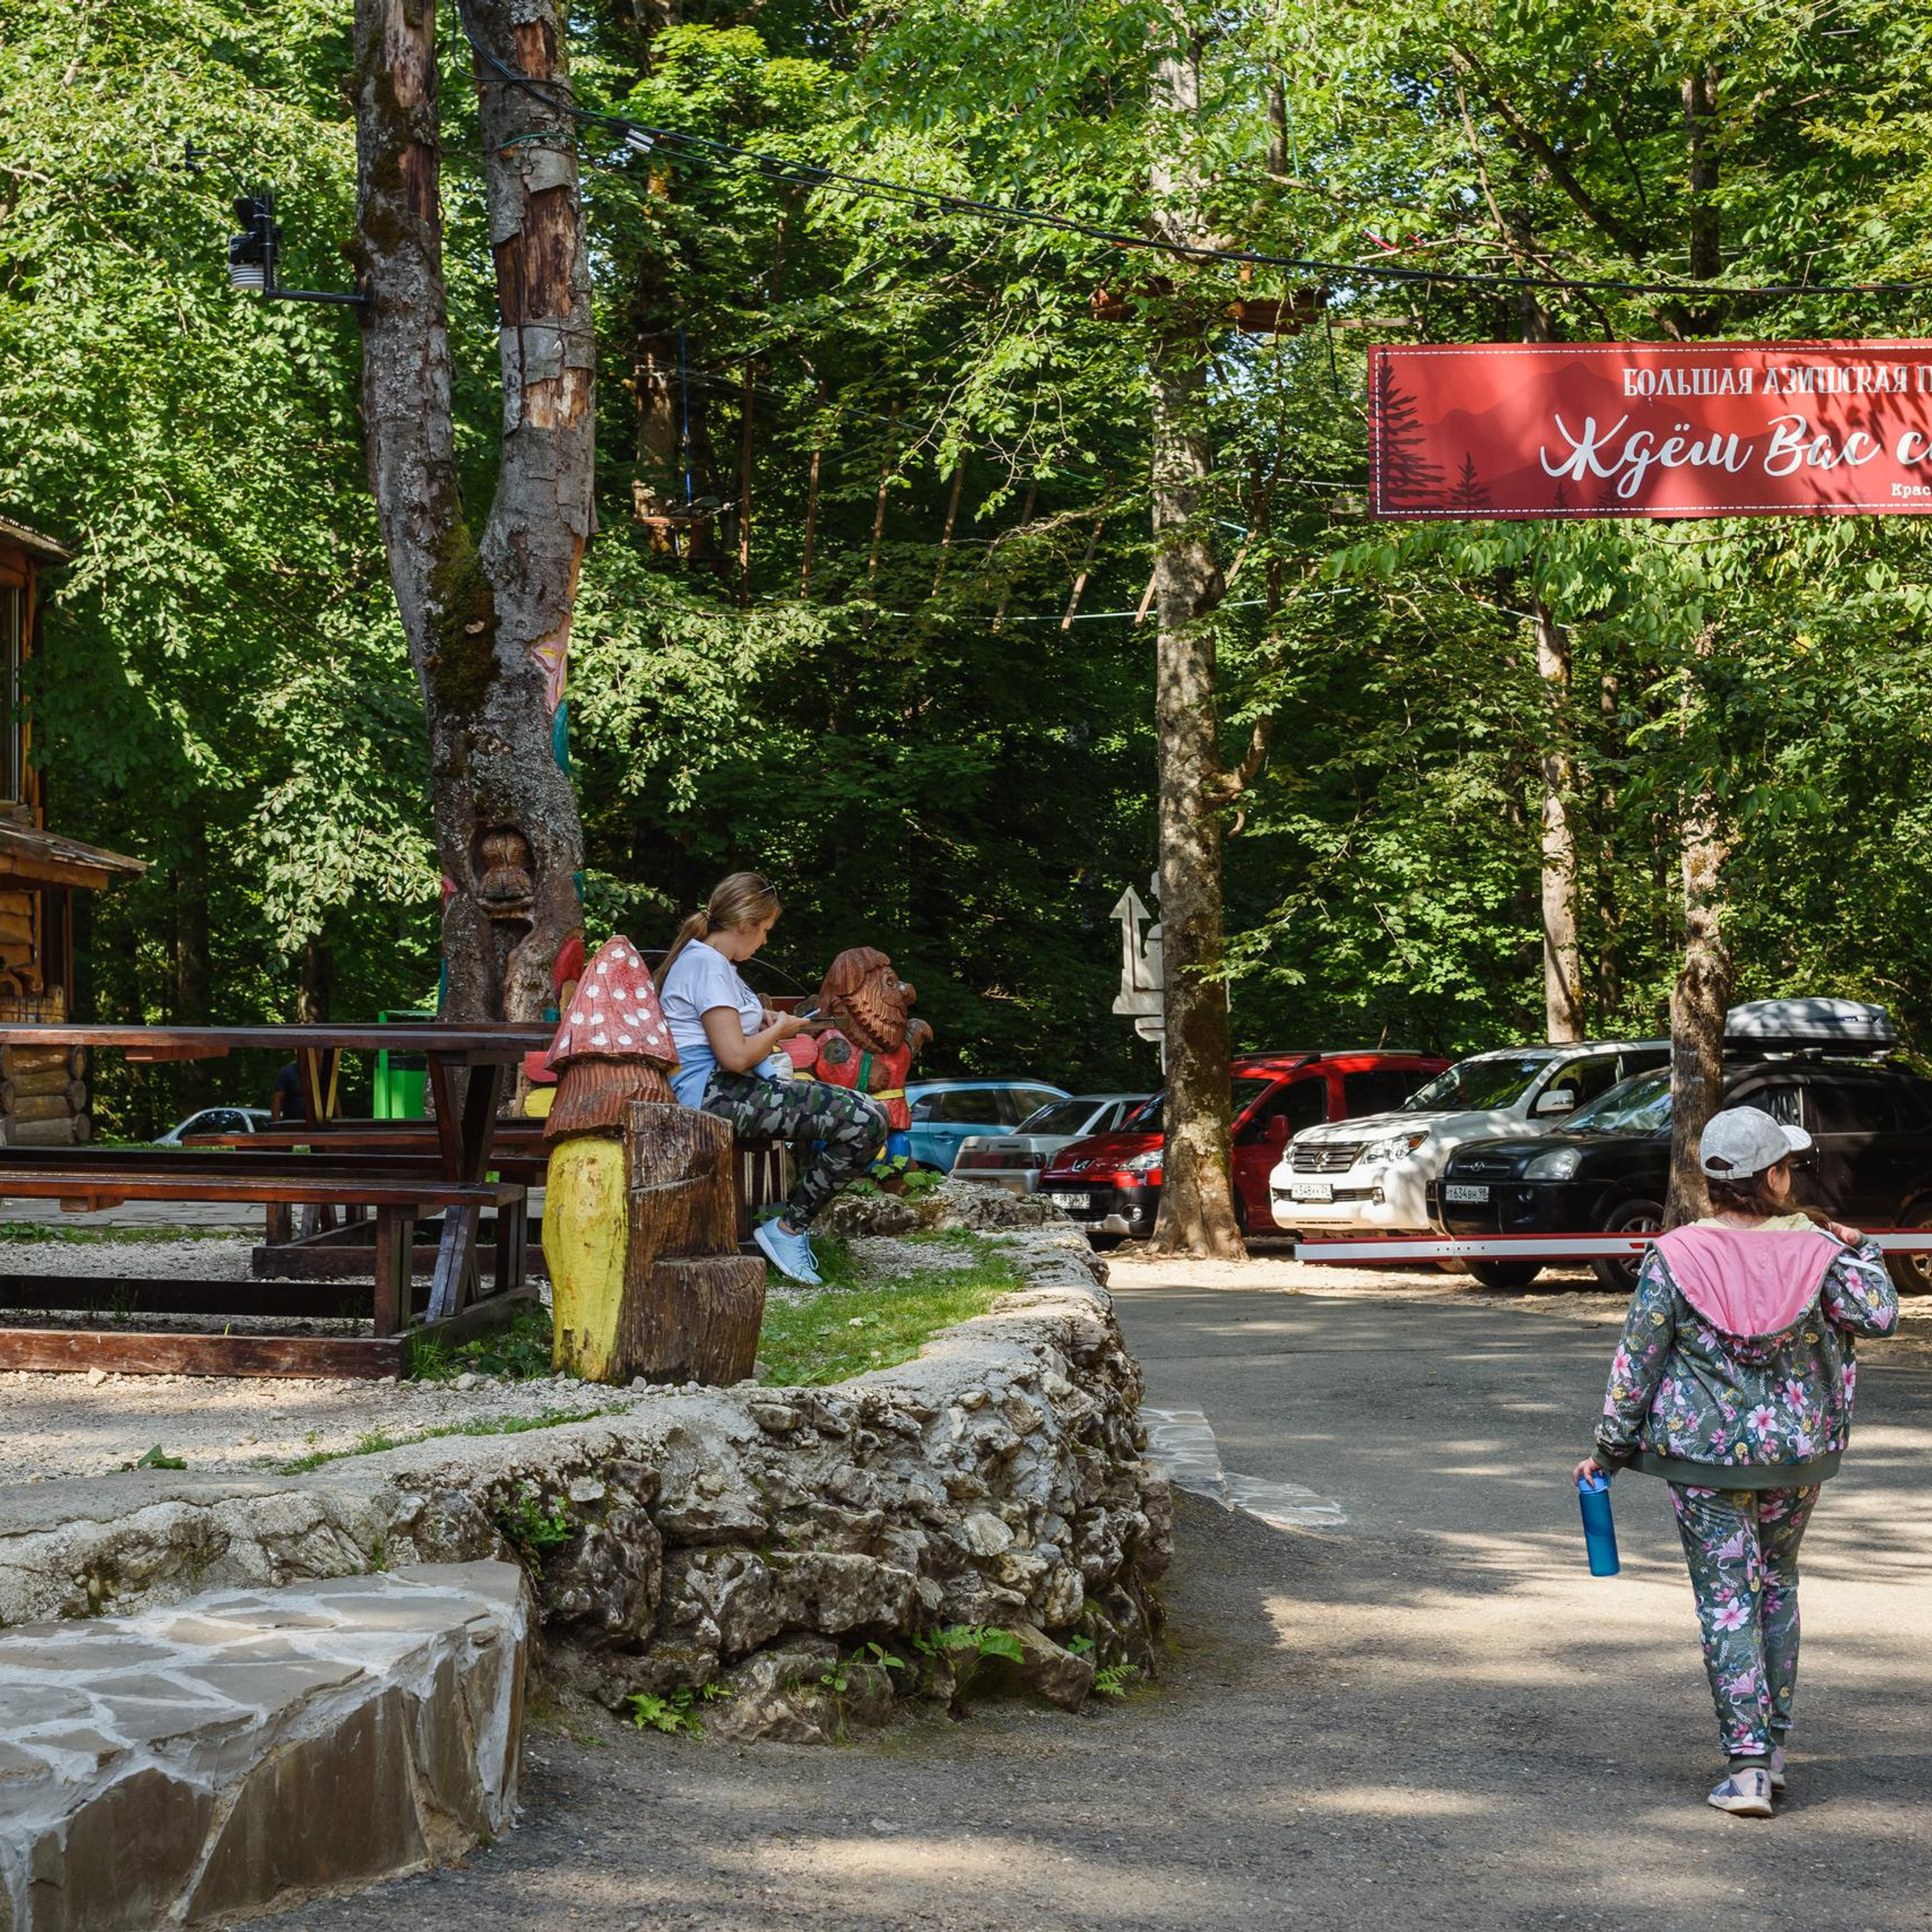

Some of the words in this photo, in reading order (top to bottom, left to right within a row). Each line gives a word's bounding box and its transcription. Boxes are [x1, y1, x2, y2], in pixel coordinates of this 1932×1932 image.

[1622, 367, 1753, 396] БОЛЬШАЯ
[1761, 365, 1908, 395] АЗИШСКАЯ
[1540, 414, 1753, 498] Ждём
[1763, 414, 1881, 477] Вас
[1897, 431, 1932, 465] с
[1891, 483, 1932, 499] Крас
